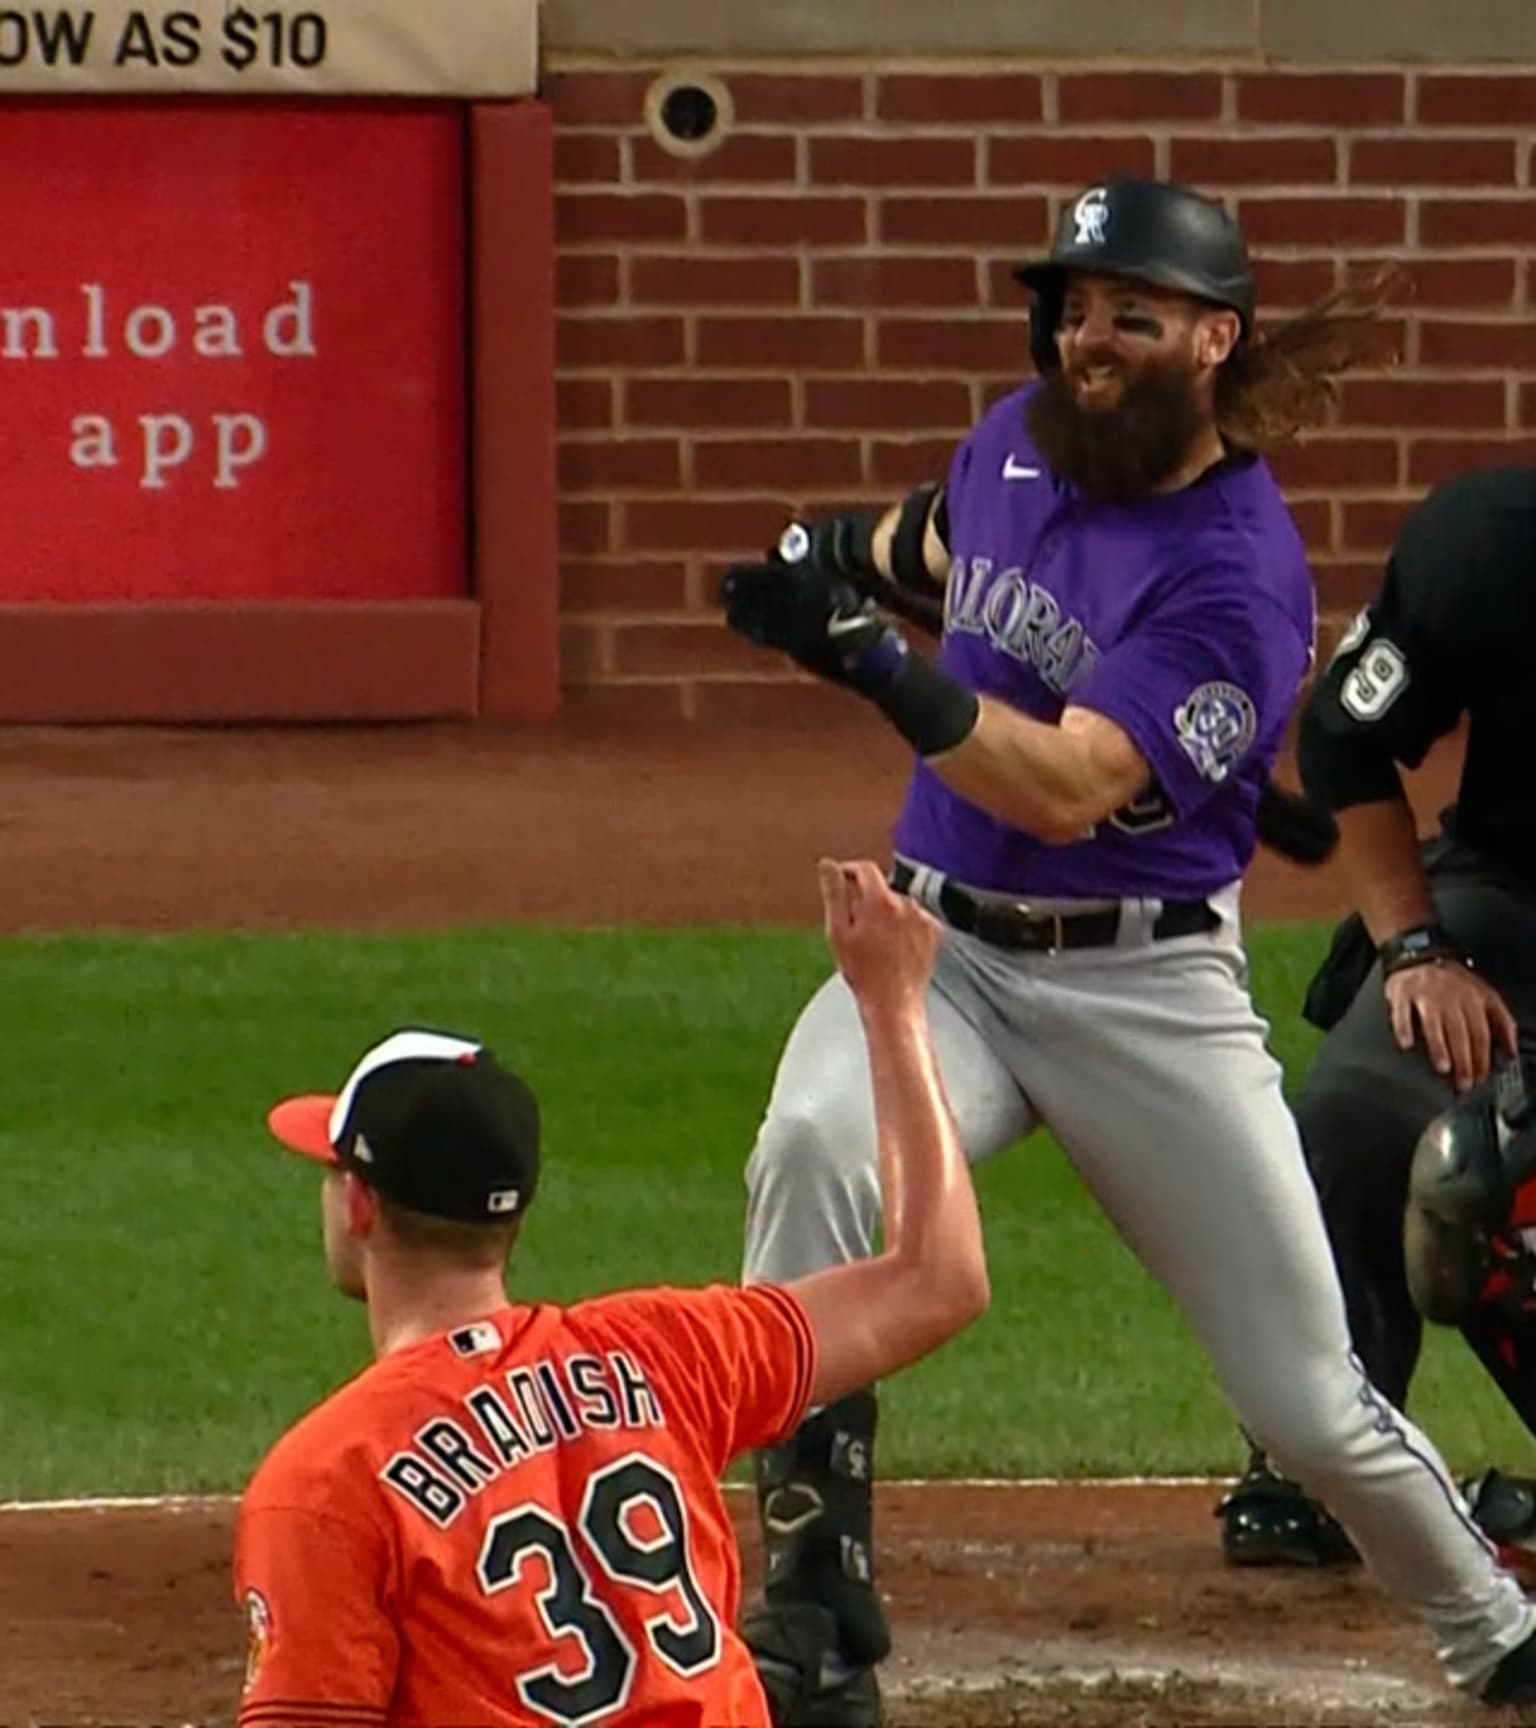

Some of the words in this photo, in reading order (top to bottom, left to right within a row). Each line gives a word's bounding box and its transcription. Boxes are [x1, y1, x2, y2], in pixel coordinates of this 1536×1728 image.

[114, 11, 201, 67] AS
[221, 6, 327, 72] $10
[0, 281, 318, 358] nload
[69, 413, 267, 489] app
[380, 1352, 665, 1529] BRADISH
[477, 1452, 722, 1728] 39
